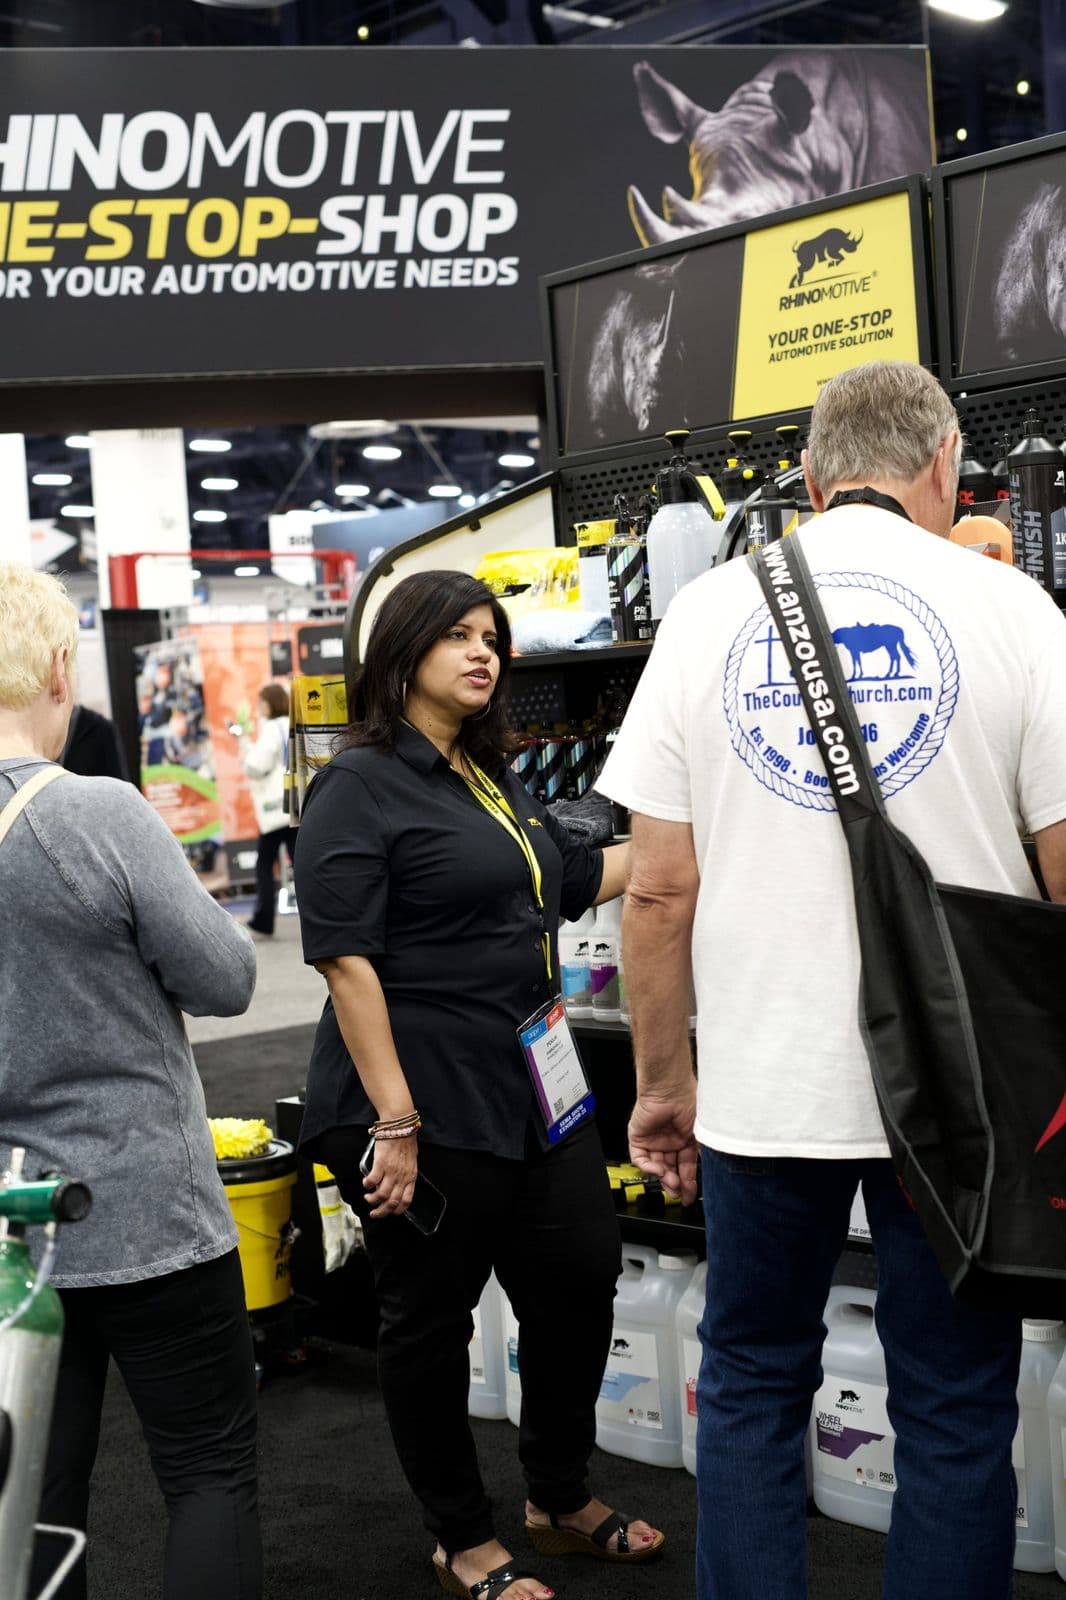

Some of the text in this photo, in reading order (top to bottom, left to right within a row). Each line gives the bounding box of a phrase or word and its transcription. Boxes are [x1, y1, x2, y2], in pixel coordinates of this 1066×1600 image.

[0, 193, 517, 262] E-STOP-SHOP
[41, 265, 145, 297] YOUR
[152, 260, 397, 294] AUTOMOTIVE
[404, 257, 519, 288] NEEDS
[779, 276, 871, 311] RHINOMOTIVE
[768, 308, 892, 348] YOUR ONE-STOP
[768, 328, 894, 363] AUTOMOTIVE SOLUTION
[1009, 473, 1025, 570] LTIMATE
[762, 745, 791, 772] 1998
[884, 713, 930, 767] Welcome
[879, 1471, 894, 1481] PRO
